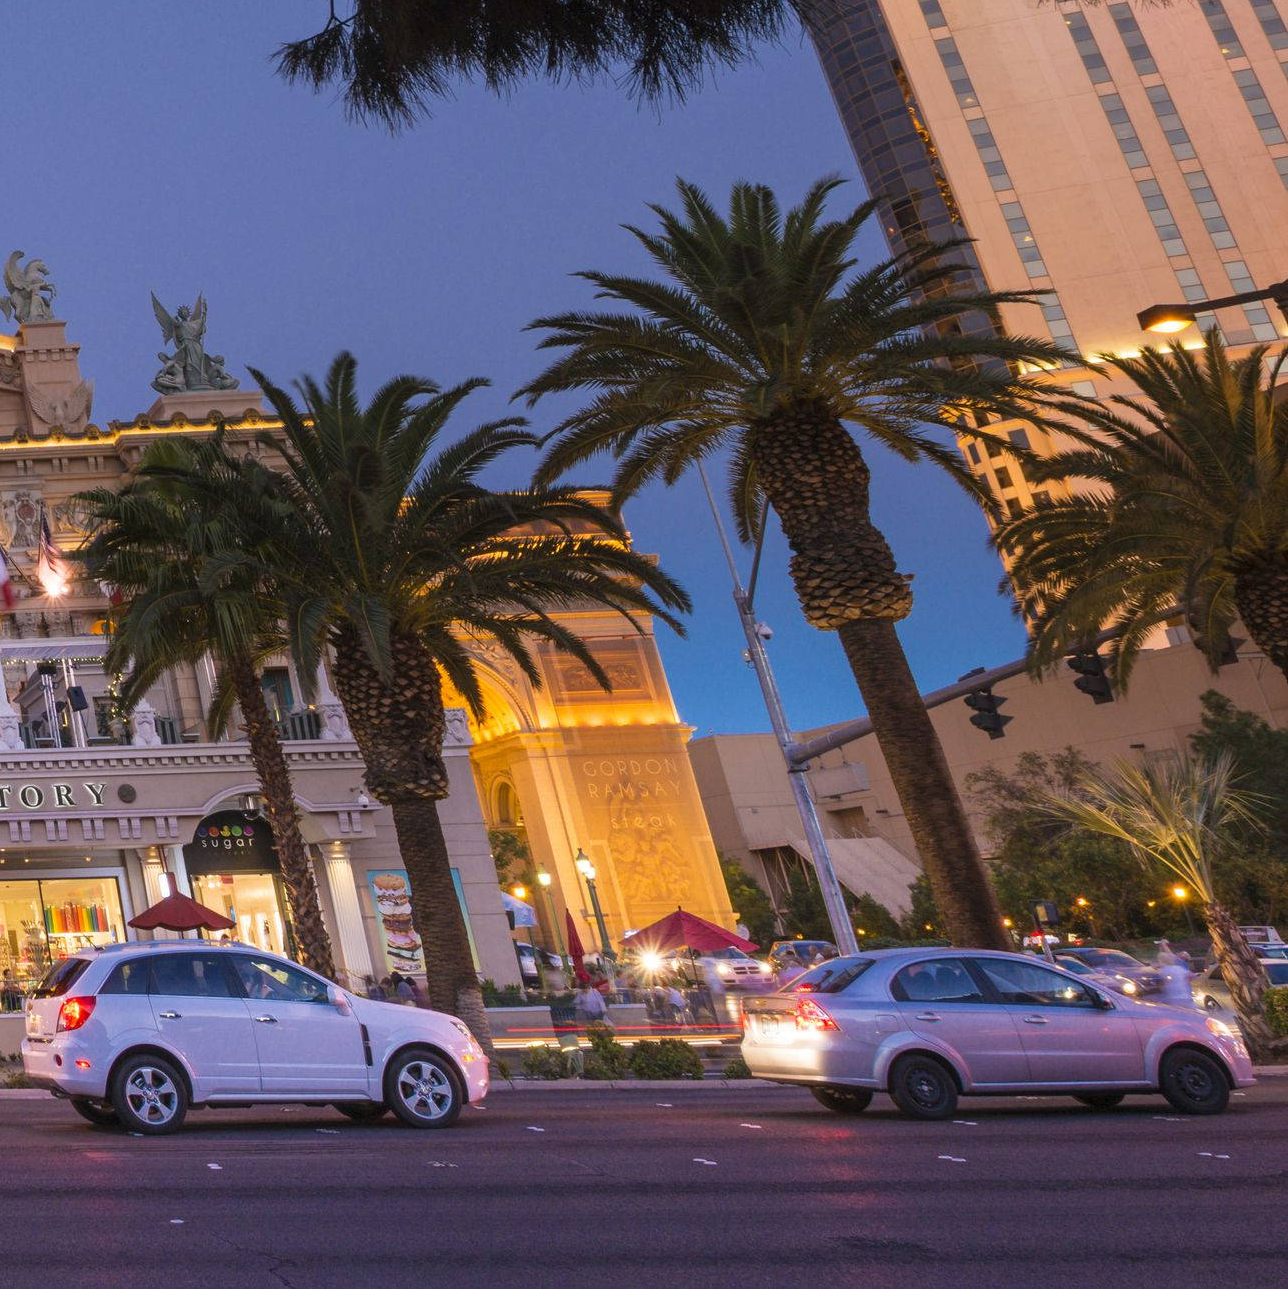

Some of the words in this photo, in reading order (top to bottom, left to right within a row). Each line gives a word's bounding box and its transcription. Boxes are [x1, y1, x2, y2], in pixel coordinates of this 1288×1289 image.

[582, 758, 679, 777] GORDON
[587, 780, 681, 800] RAMSAY
[609, 812, 677, 829] steak
[201, 838, 255, 850] sugar
